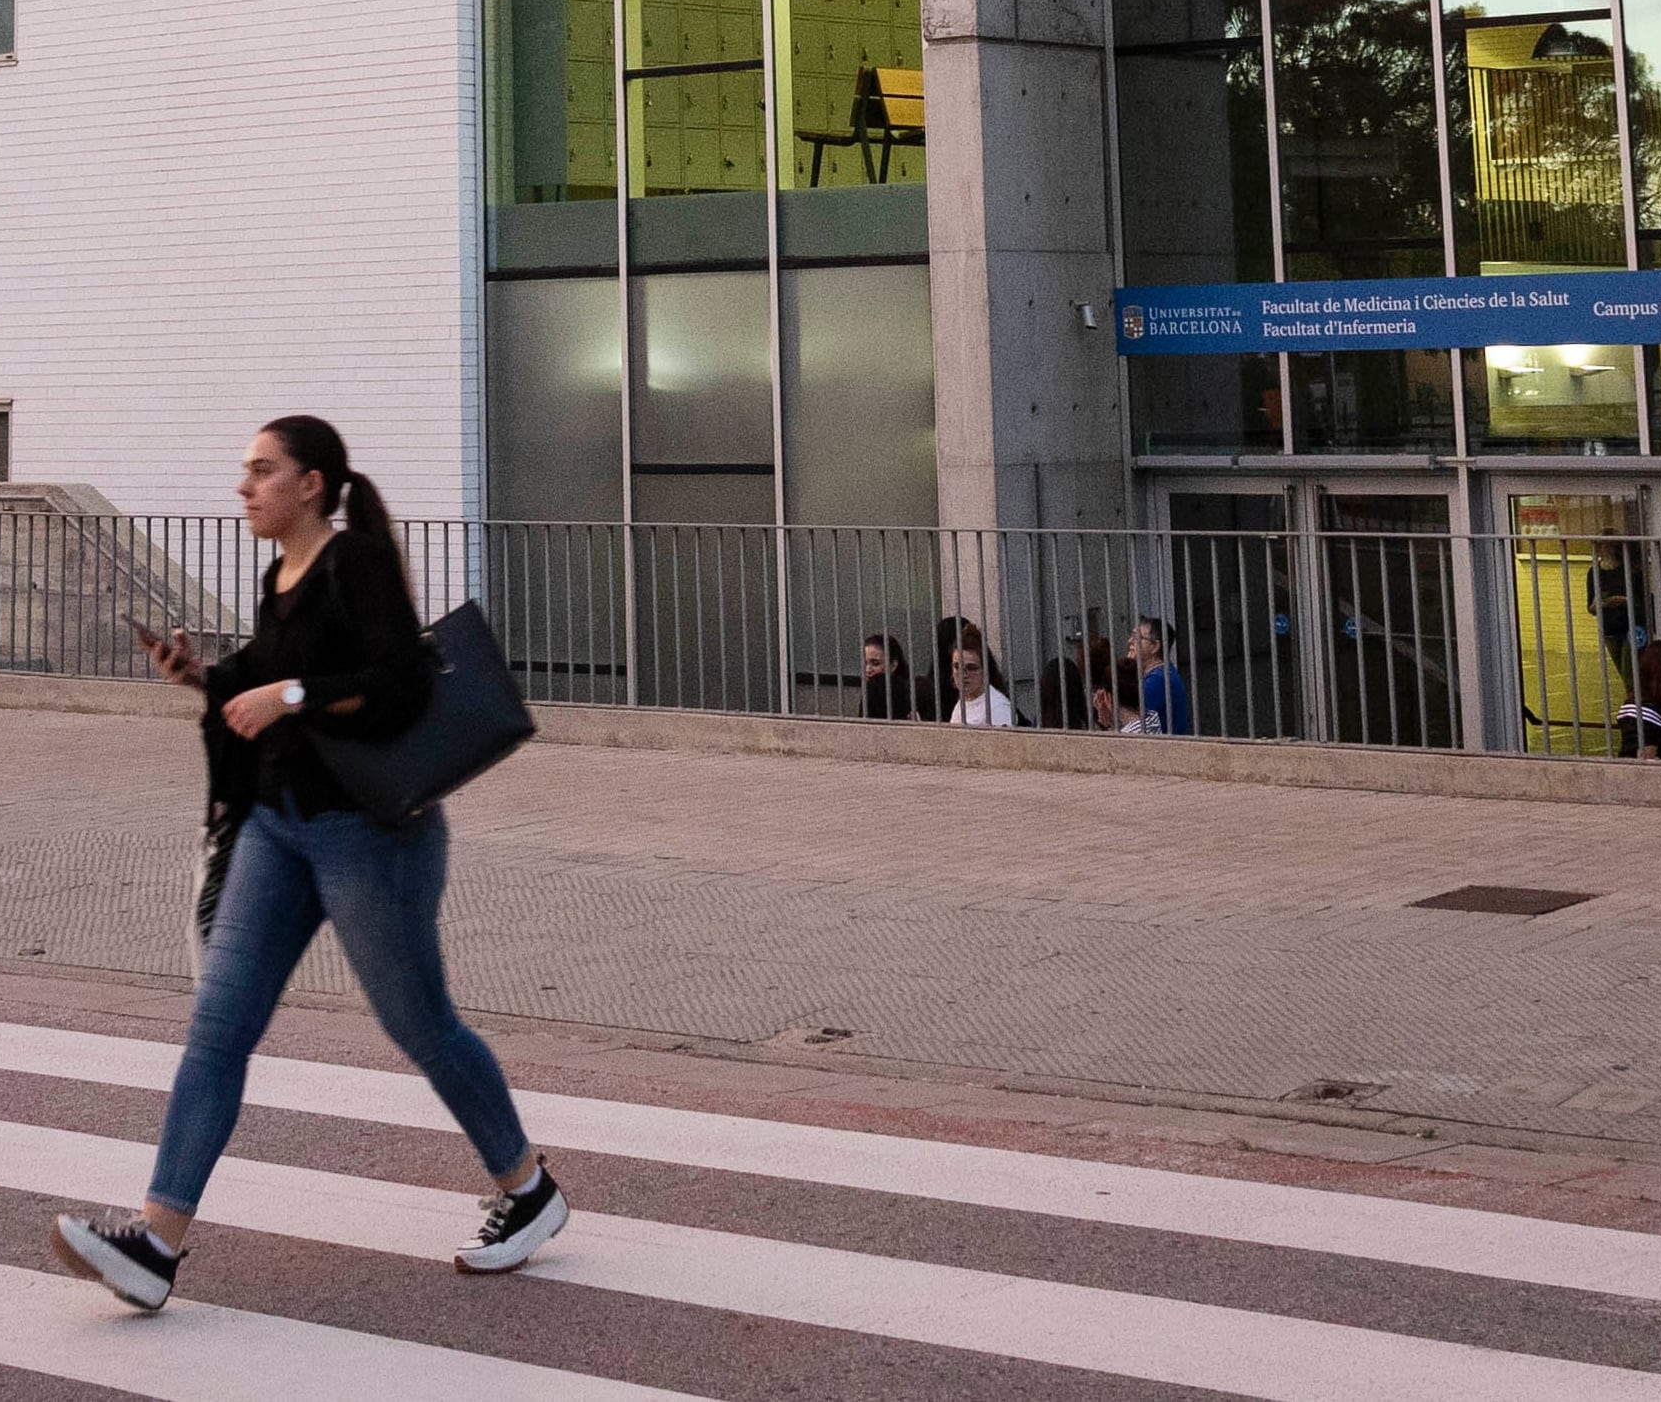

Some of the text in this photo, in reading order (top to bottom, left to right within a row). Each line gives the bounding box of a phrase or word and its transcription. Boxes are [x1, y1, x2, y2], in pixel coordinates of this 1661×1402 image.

[1262, 291, 1570, 315] Facultat de Medicina i Ciències de la Salut
[1593, 301, 1658, 319] Campus
[1149, 307, 1230, 320] UNIVERSITAT
[1149, 320, 1243, 336] BARCELONA
[1263, 319, 1416, 337] Facultat d'Infermeria
